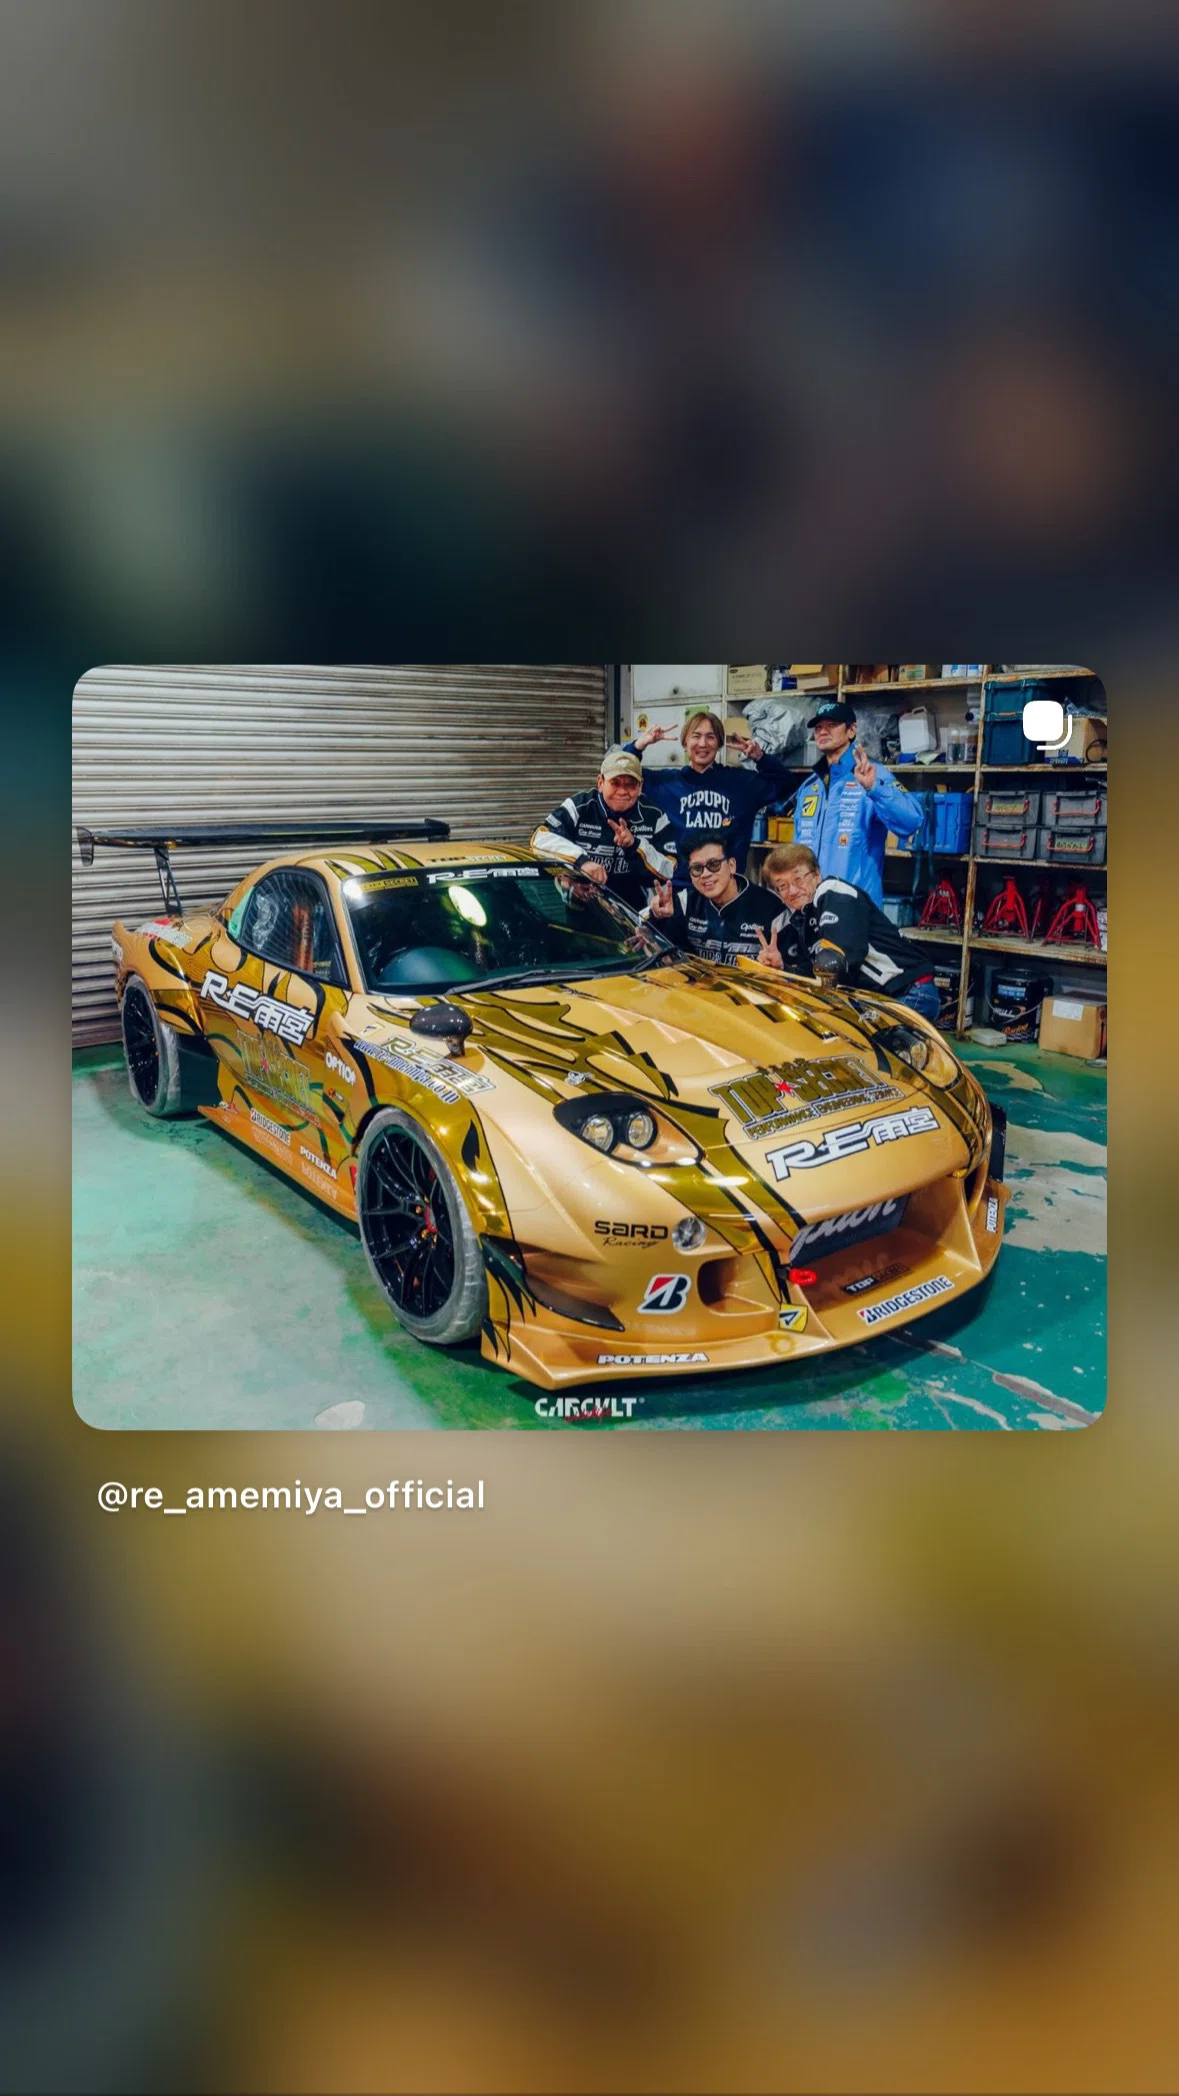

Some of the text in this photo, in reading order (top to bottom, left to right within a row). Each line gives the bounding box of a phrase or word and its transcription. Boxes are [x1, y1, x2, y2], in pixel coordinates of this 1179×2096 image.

[679, 790, 731, 814] PUPUPU
[685, 810, 722, 829] LAND
[250, 1108, 291, 1147] BRIDGESTONE
[300, 1145, 338, 1180] POTENZA
[845, 1277, 876, 1293] TOP
[859, 1276, 953, 1324] BRIDGESTONE
[597, 1352, 709, 1365] POTENZA
